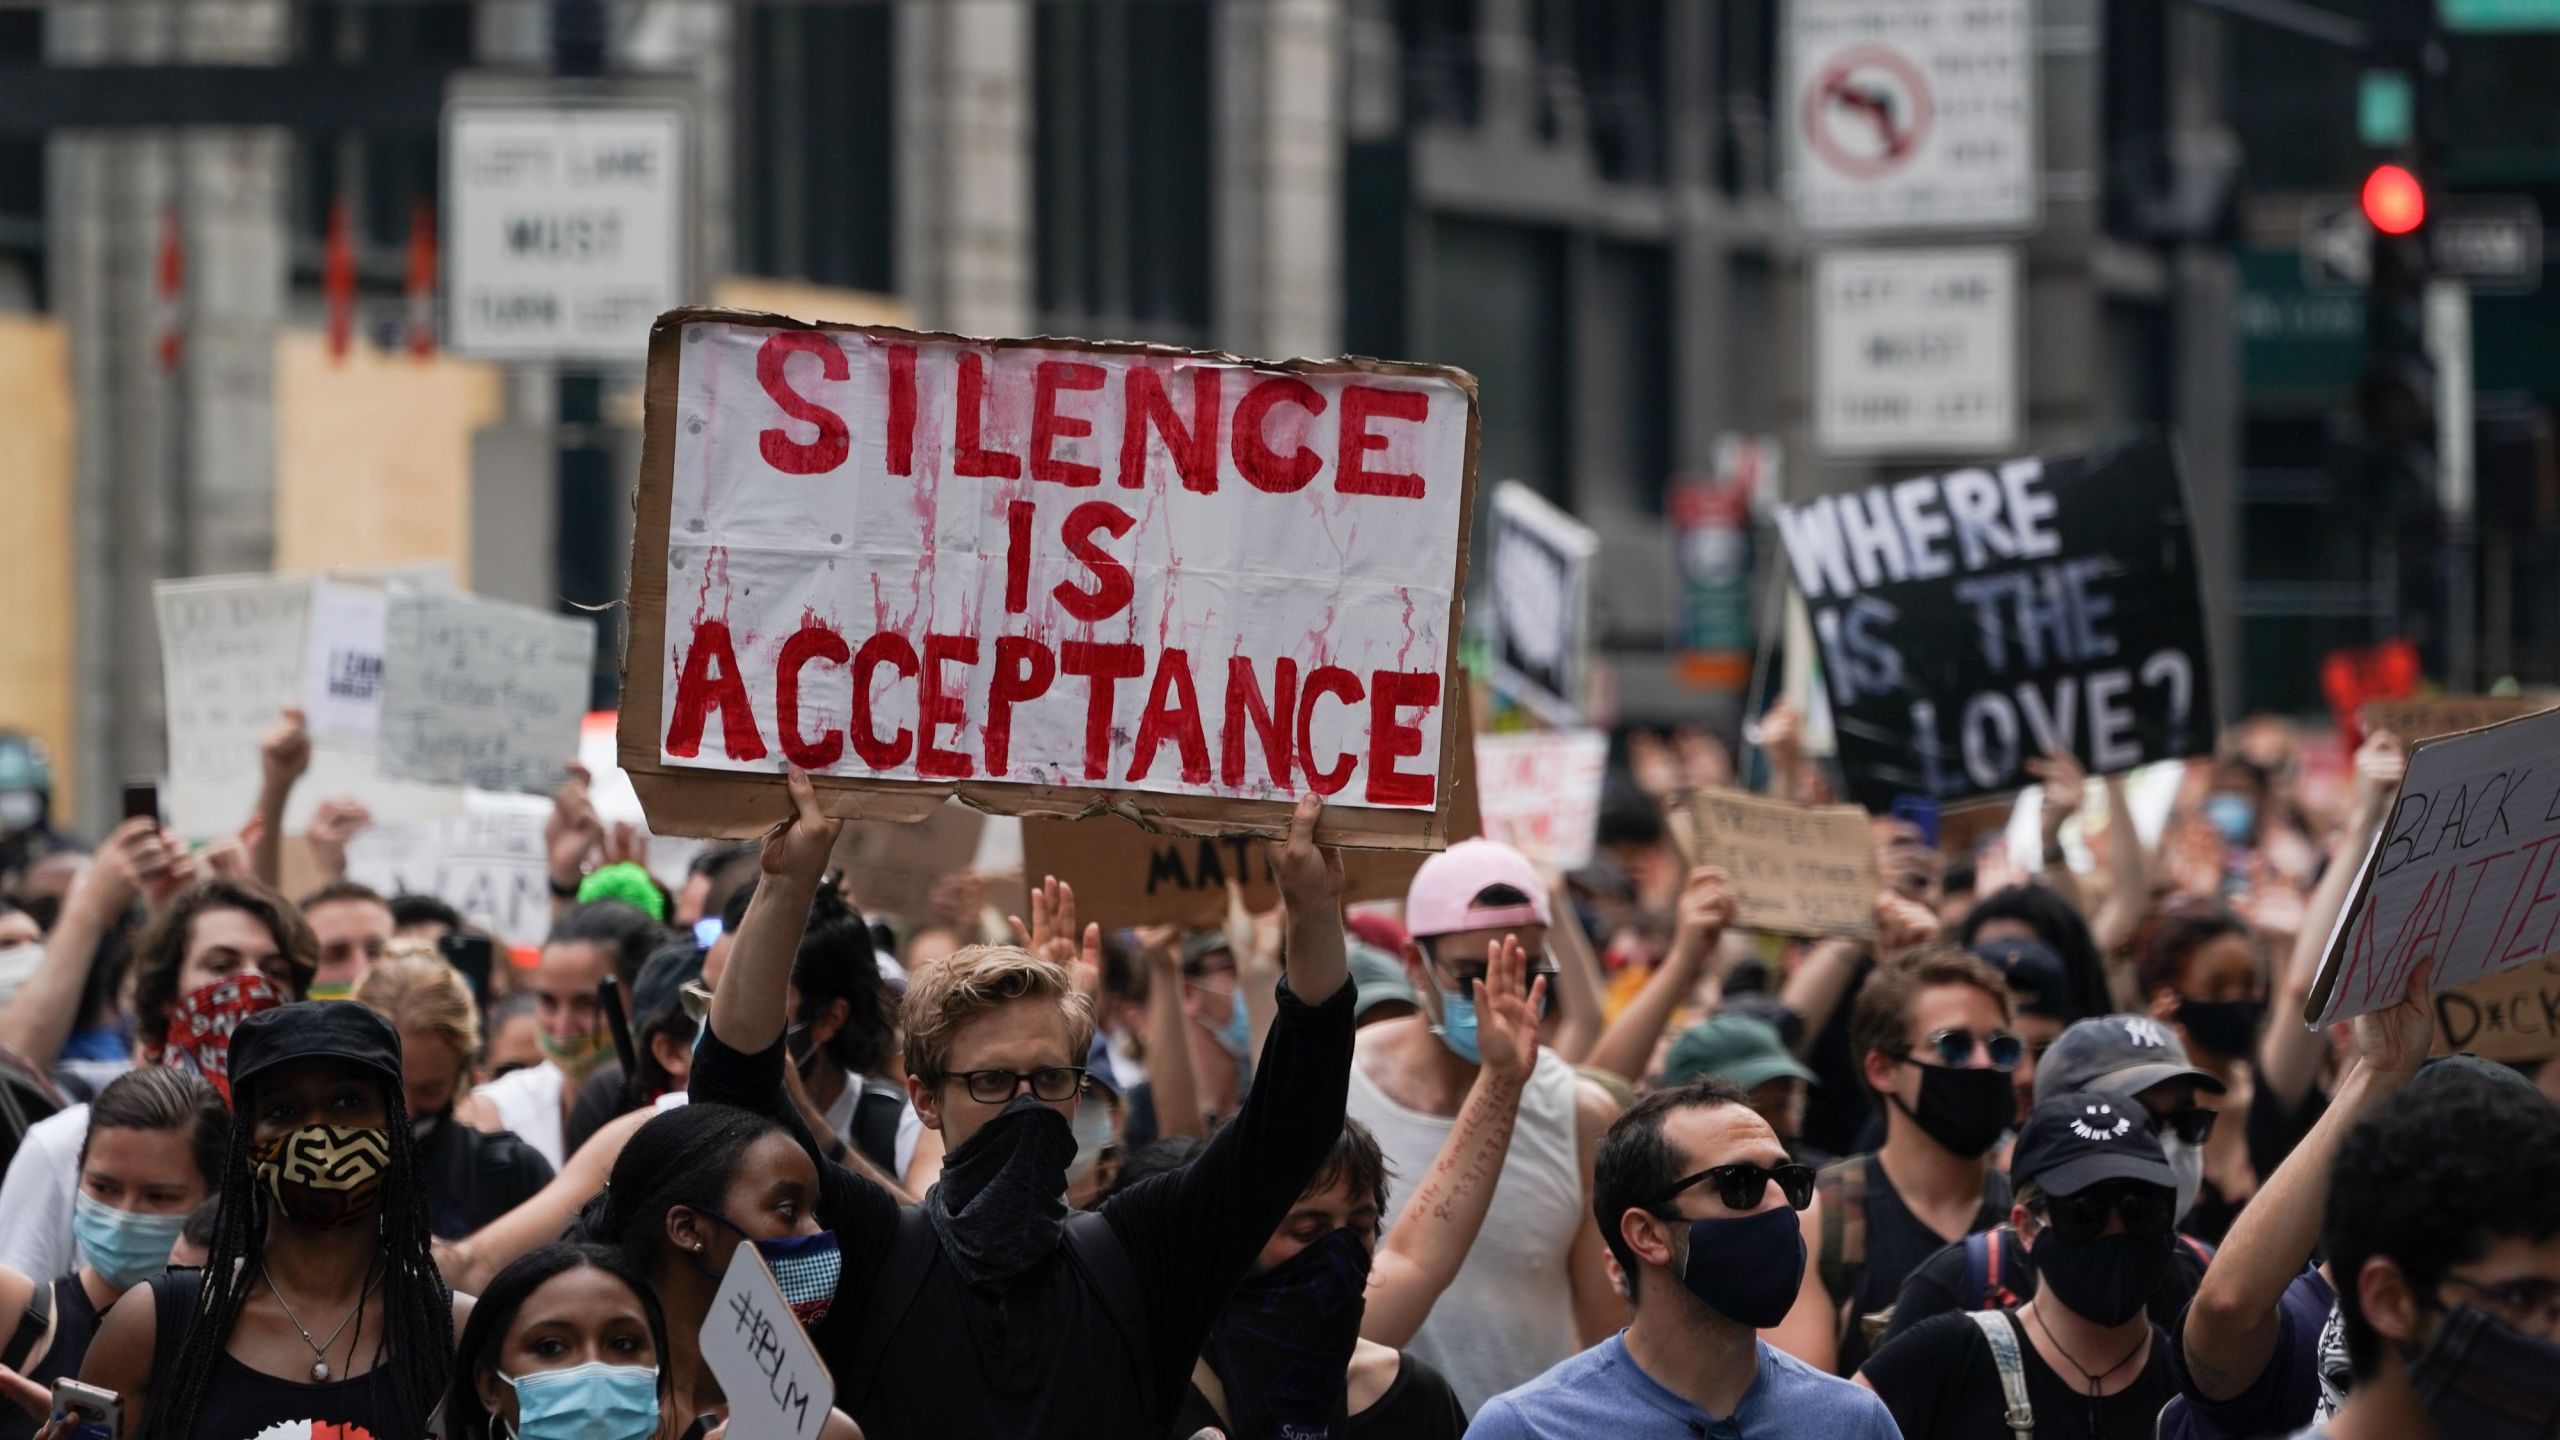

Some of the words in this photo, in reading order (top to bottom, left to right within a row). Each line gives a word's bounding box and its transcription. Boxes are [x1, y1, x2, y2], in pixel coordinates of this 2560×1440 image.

[757, 331, 1429, 498] SILENCE
[1004, 500, 1137, 621] IS
[1774, 457, 2062, 598] WHERE
[1816, 597, 1901, 707] IS
[1955, 557, 2119, 673] THE
[665, 617, 1440, 805] ACCEPTANCE
[1911, 648, 2193, 797] LOVE?
[1147, 835, 1276, 895] MAT
[2378, 769, 2532, 877] BLACK
[2124, 1016, 2165, 1048] NY
[729, 1290, 809, 1435] #BLM
